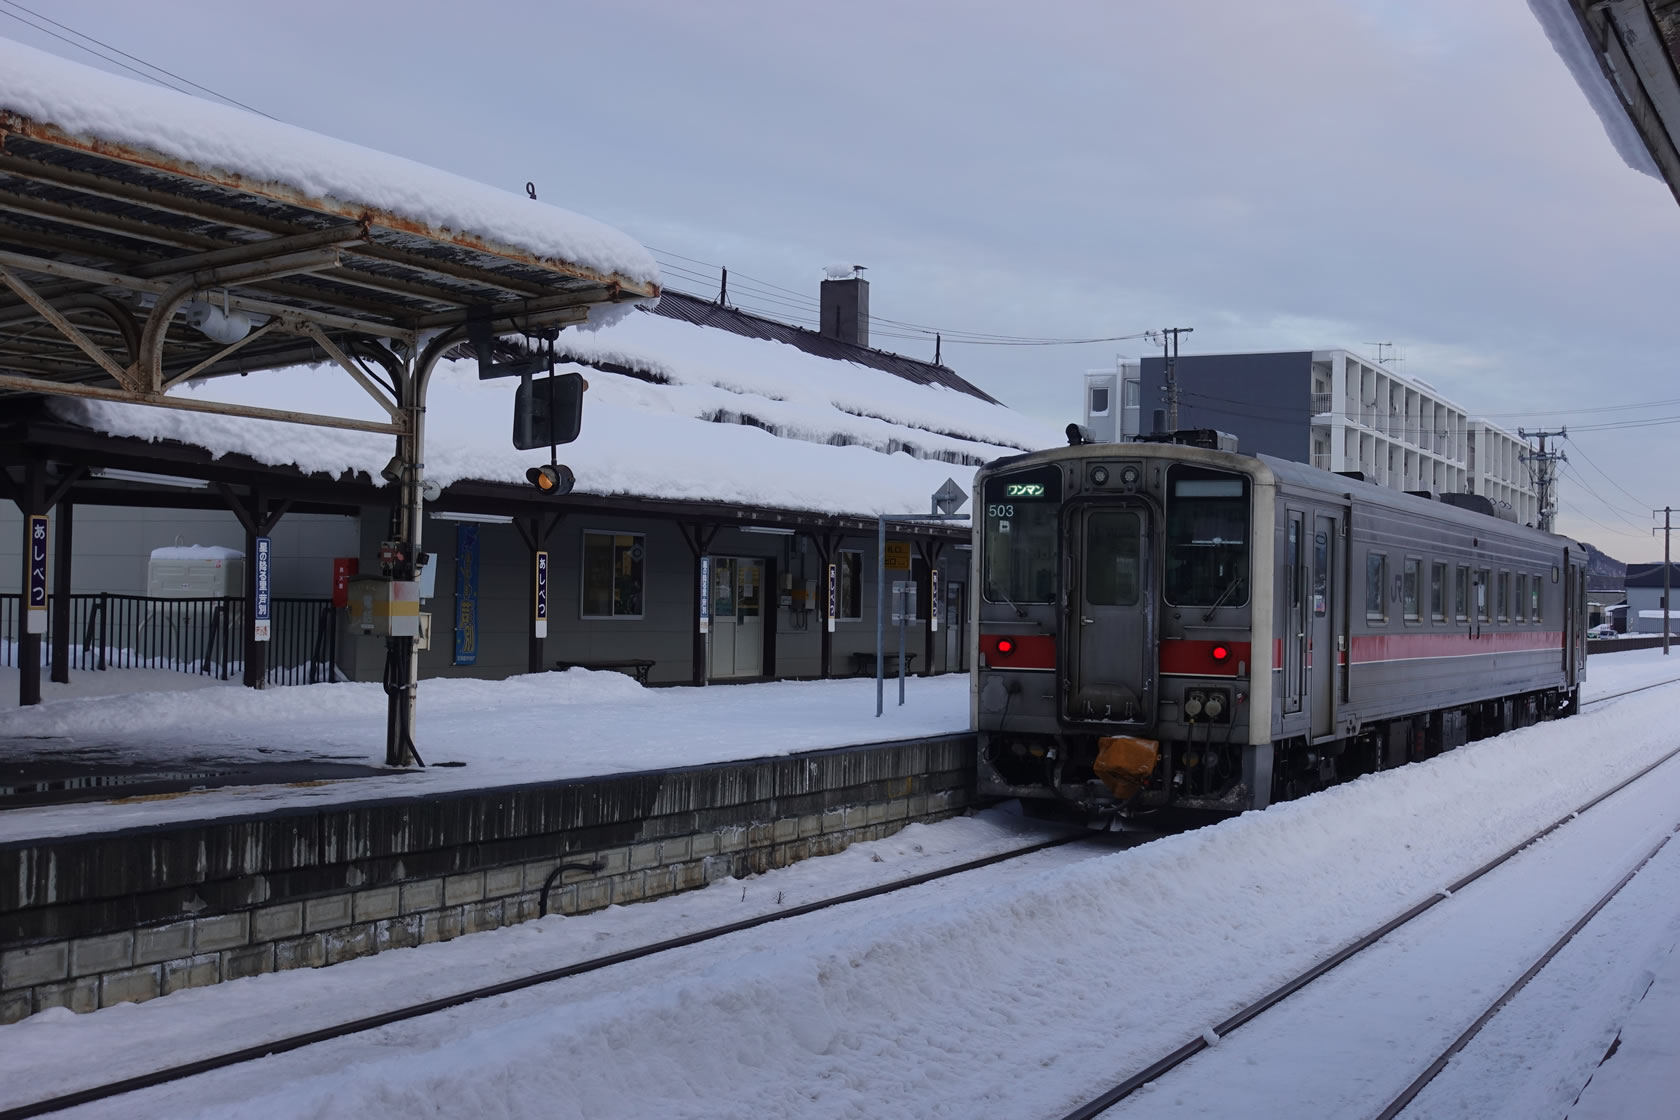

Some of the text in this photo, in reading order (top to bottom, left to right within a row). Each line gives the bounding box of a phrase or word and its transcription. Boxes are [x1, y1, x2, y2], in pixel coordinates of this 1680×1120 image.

[1008, 485, 1044, 495] ワンマン
[989, 504, 1014, 517] 503
[33, 524, 45, 600] あしべつ
[1390, 574, 1402, 603] JR
